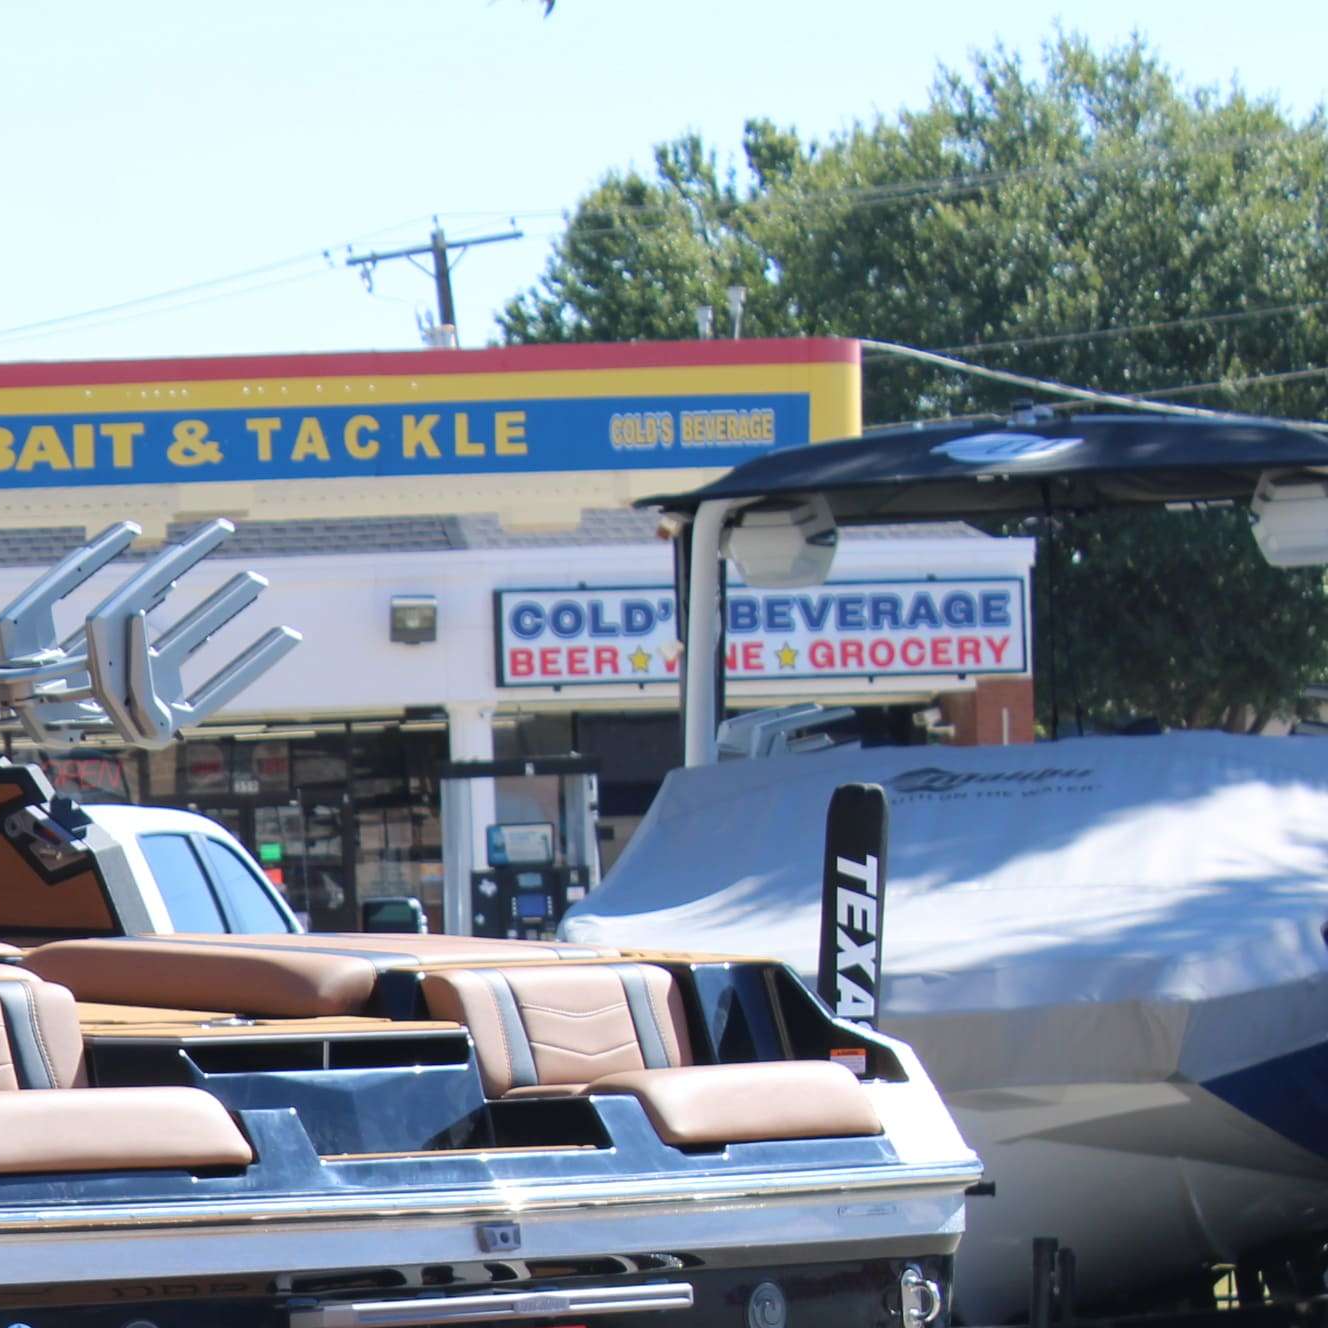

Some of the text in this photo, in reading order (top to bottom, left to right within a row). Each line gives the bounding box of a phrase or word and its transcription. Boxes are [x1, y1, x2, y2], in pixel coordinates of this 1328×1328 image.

[166, 420, 224, 467] &
[246, 411, 528, 462] TACKLE
[610, 408, 775, 449] COLD'S BEVERAGE
[509, 590, 1012, 639] COLD' BEVERAGE
[509, 646, 620, 677] BEER
[808, 636, 1010, 669] GROCERY
[836, 854, 879, 1033] TEXA
